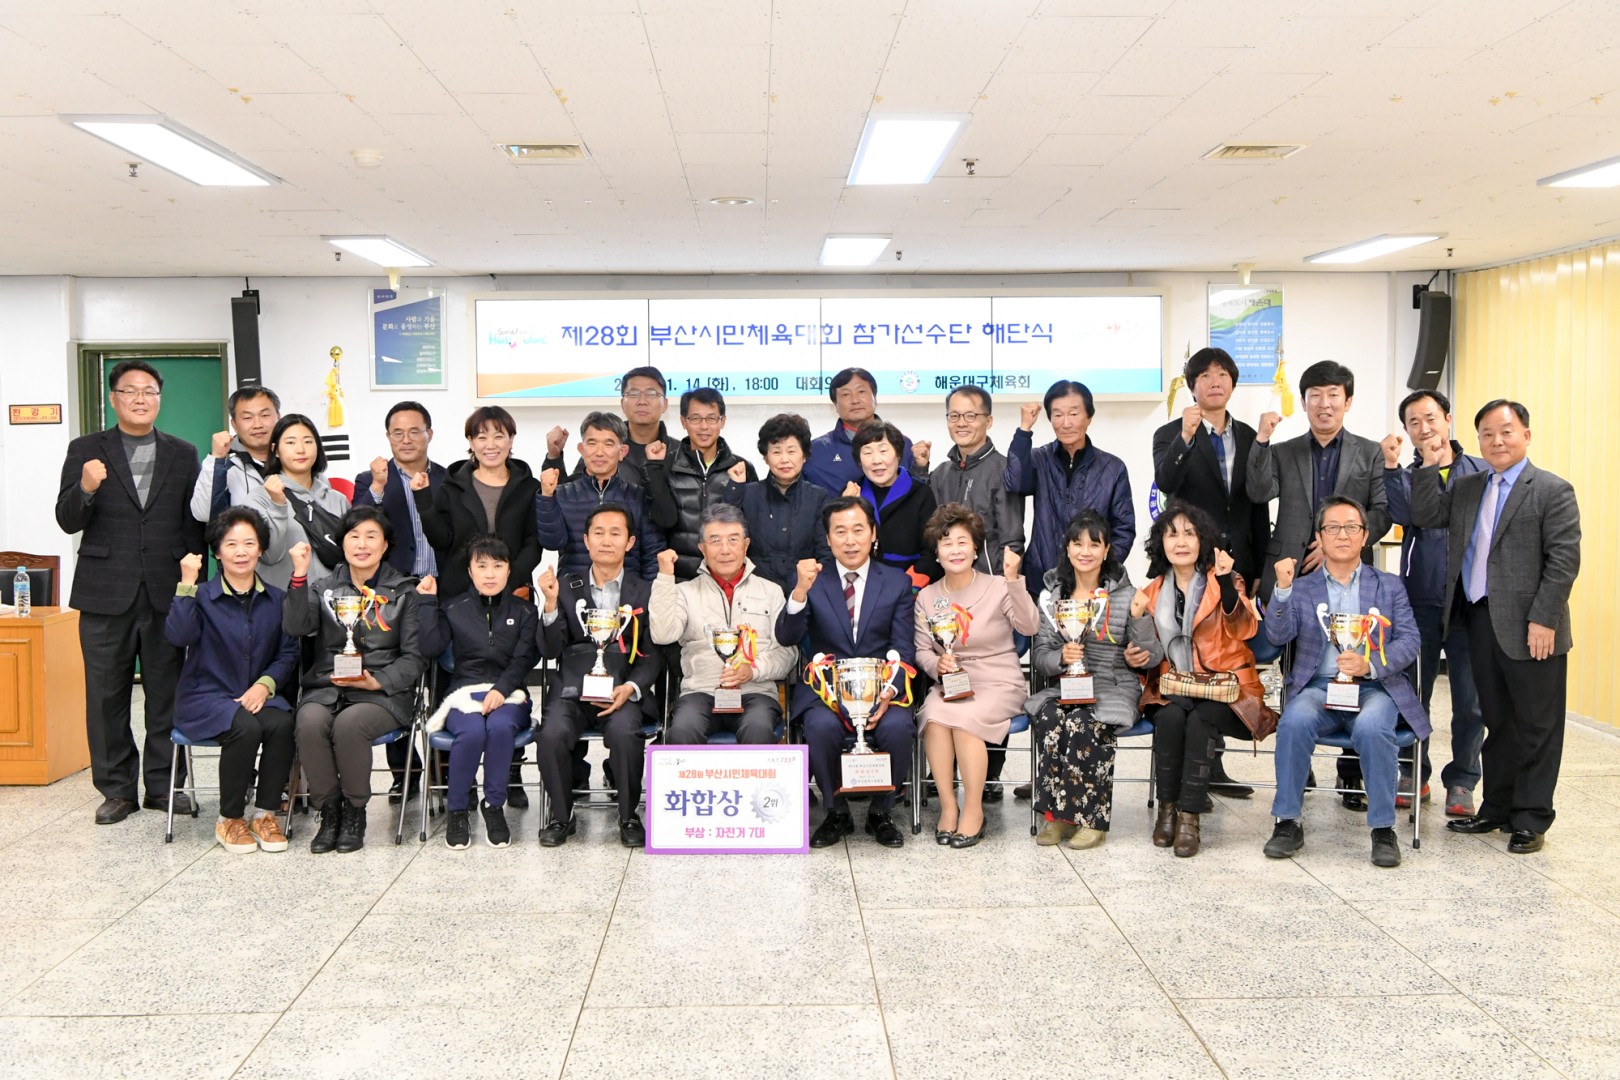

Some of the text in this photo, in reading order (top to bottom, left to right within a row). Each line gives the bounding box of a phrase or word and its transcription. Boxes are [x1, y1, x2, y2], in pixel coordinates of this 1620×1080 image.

[561, 324, 637, 346] 제28회
[650, 323, 842, 346] 부산시민체육대회
[853, 323, 973, 345] 참가선수단
[982, 322, 1053, 344] 해단식
[745, 377, 779, 391] 18:00
[934, 375, 1031, 390] 해운대구체육회
[678, 768, 777, 779] 제28회 부산시민체육대회
[664, 789, 779, 817] 화합상 2위
[685, 827, 705, 839] 부상
[715, 827, 746, 839] 자전거
[749, 827, 766, 839] 7대
